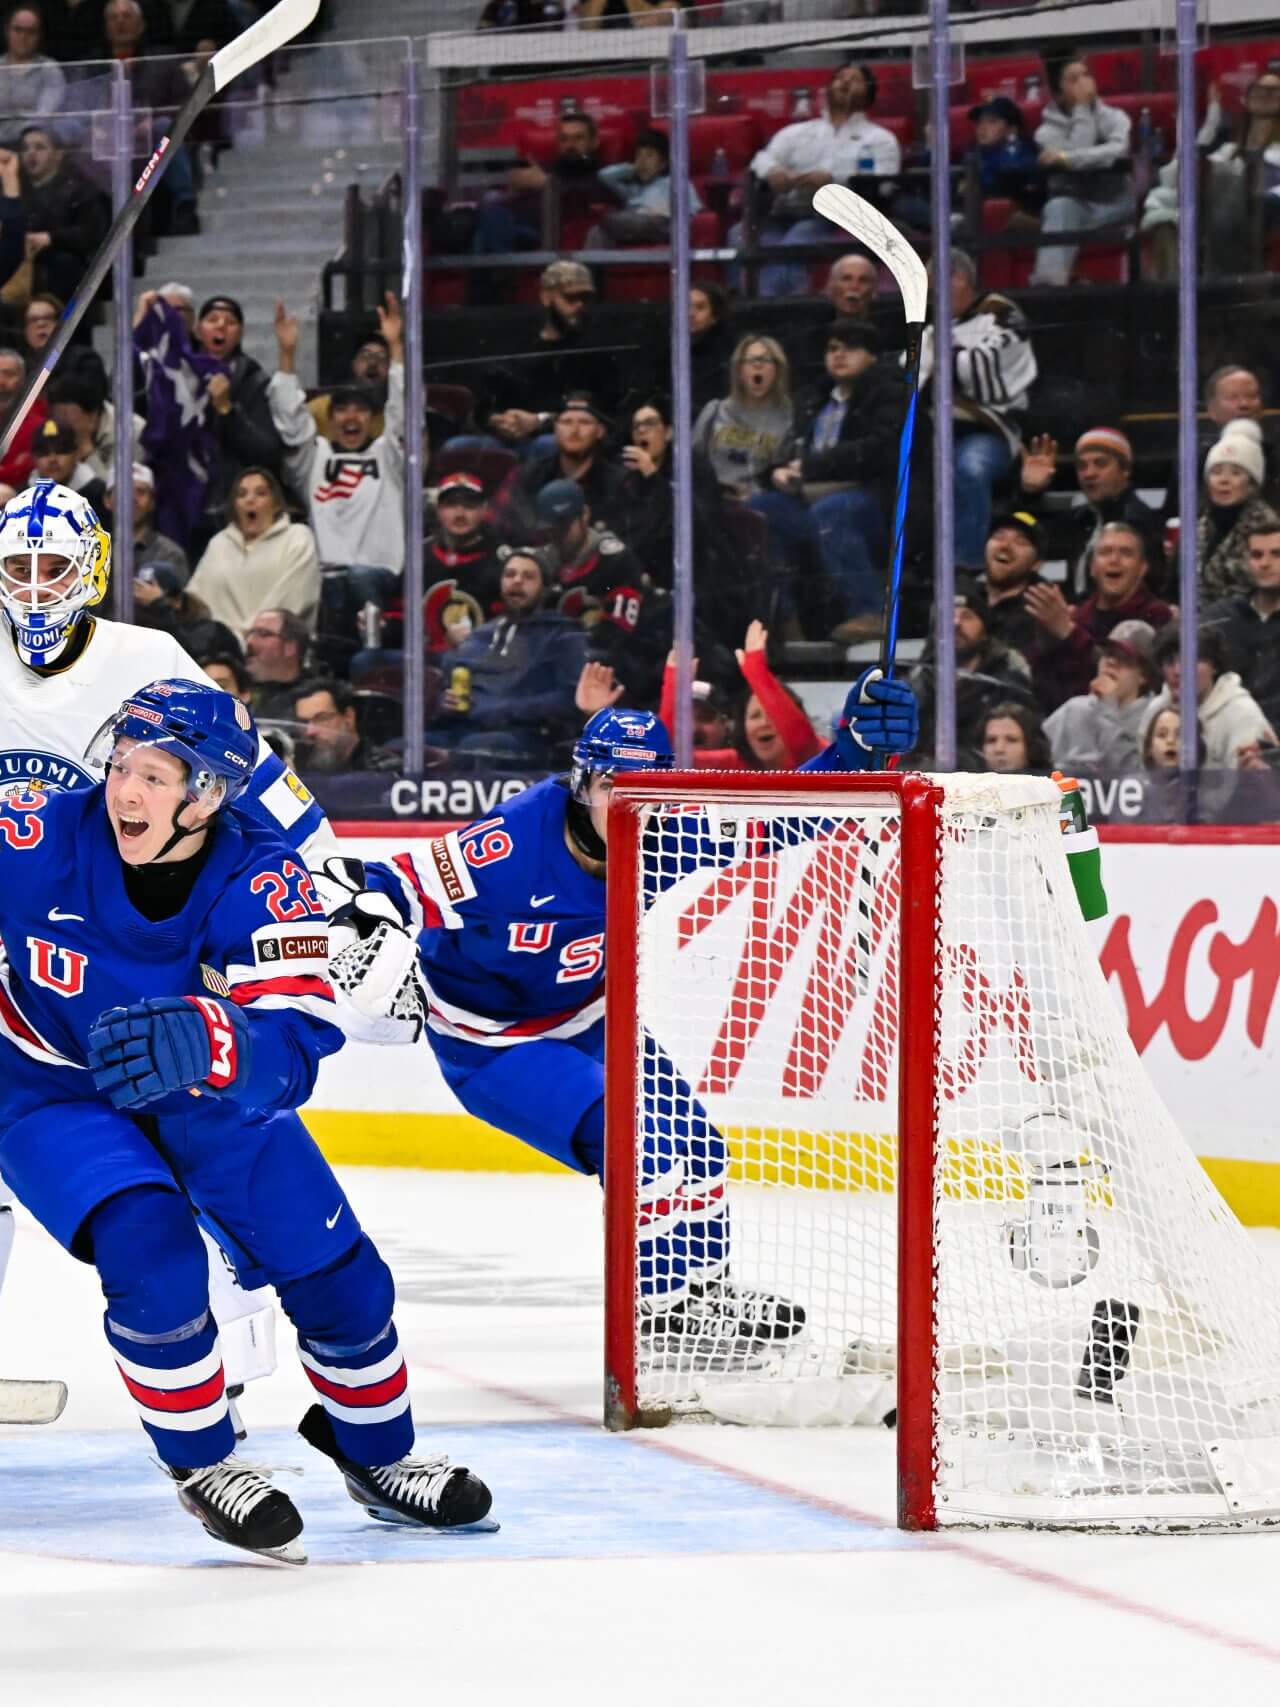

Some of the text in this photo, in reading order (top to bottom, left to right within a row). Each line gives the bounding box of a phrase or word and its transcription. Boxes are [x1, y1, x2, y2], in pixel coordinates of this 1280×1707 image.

[612, 593, 640, 627] 18
[129, 705, 161, 723] CHIPOTLE
[223, 750, 249, 769] CCM
[458, 817, 513, 868] 19
[250, 860, 326, 922] 22
[26, 935, 89, 998] U
